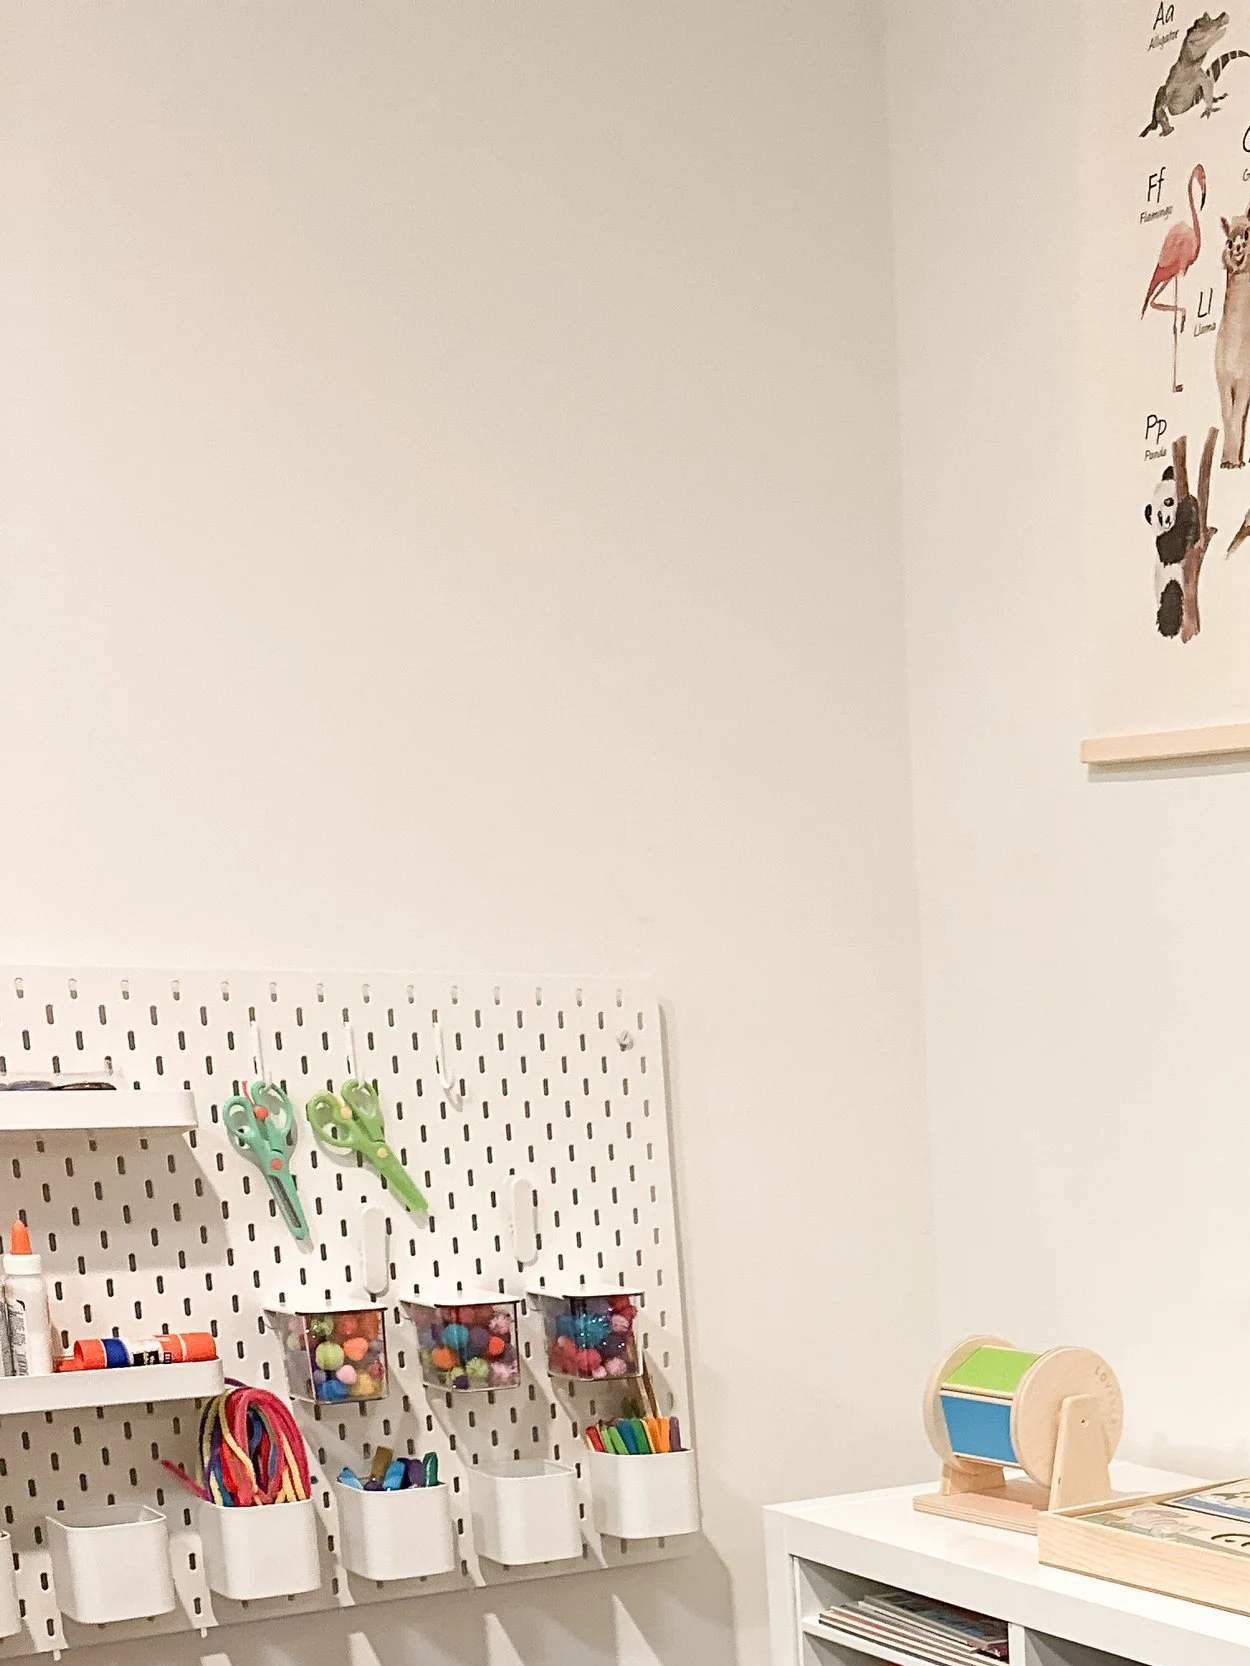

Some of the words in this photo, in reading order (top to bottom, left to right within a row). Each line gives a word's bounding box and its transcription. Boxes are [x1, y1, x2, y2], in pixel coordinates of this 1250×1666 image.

[1153, 1, 1175, 30] Aa
[1147, 30, 1179, 51] Alligator
[1147, 167, 1166, 203] Ff
[1139, 205, 1173, 224] Flamingo
[1197, 288, 1214, 319] Ll
[1193, 321, 1216, 337] Llama
[1144, 414, 1168, 443] Pp
[1144, 447, 1167, 461] Panda
